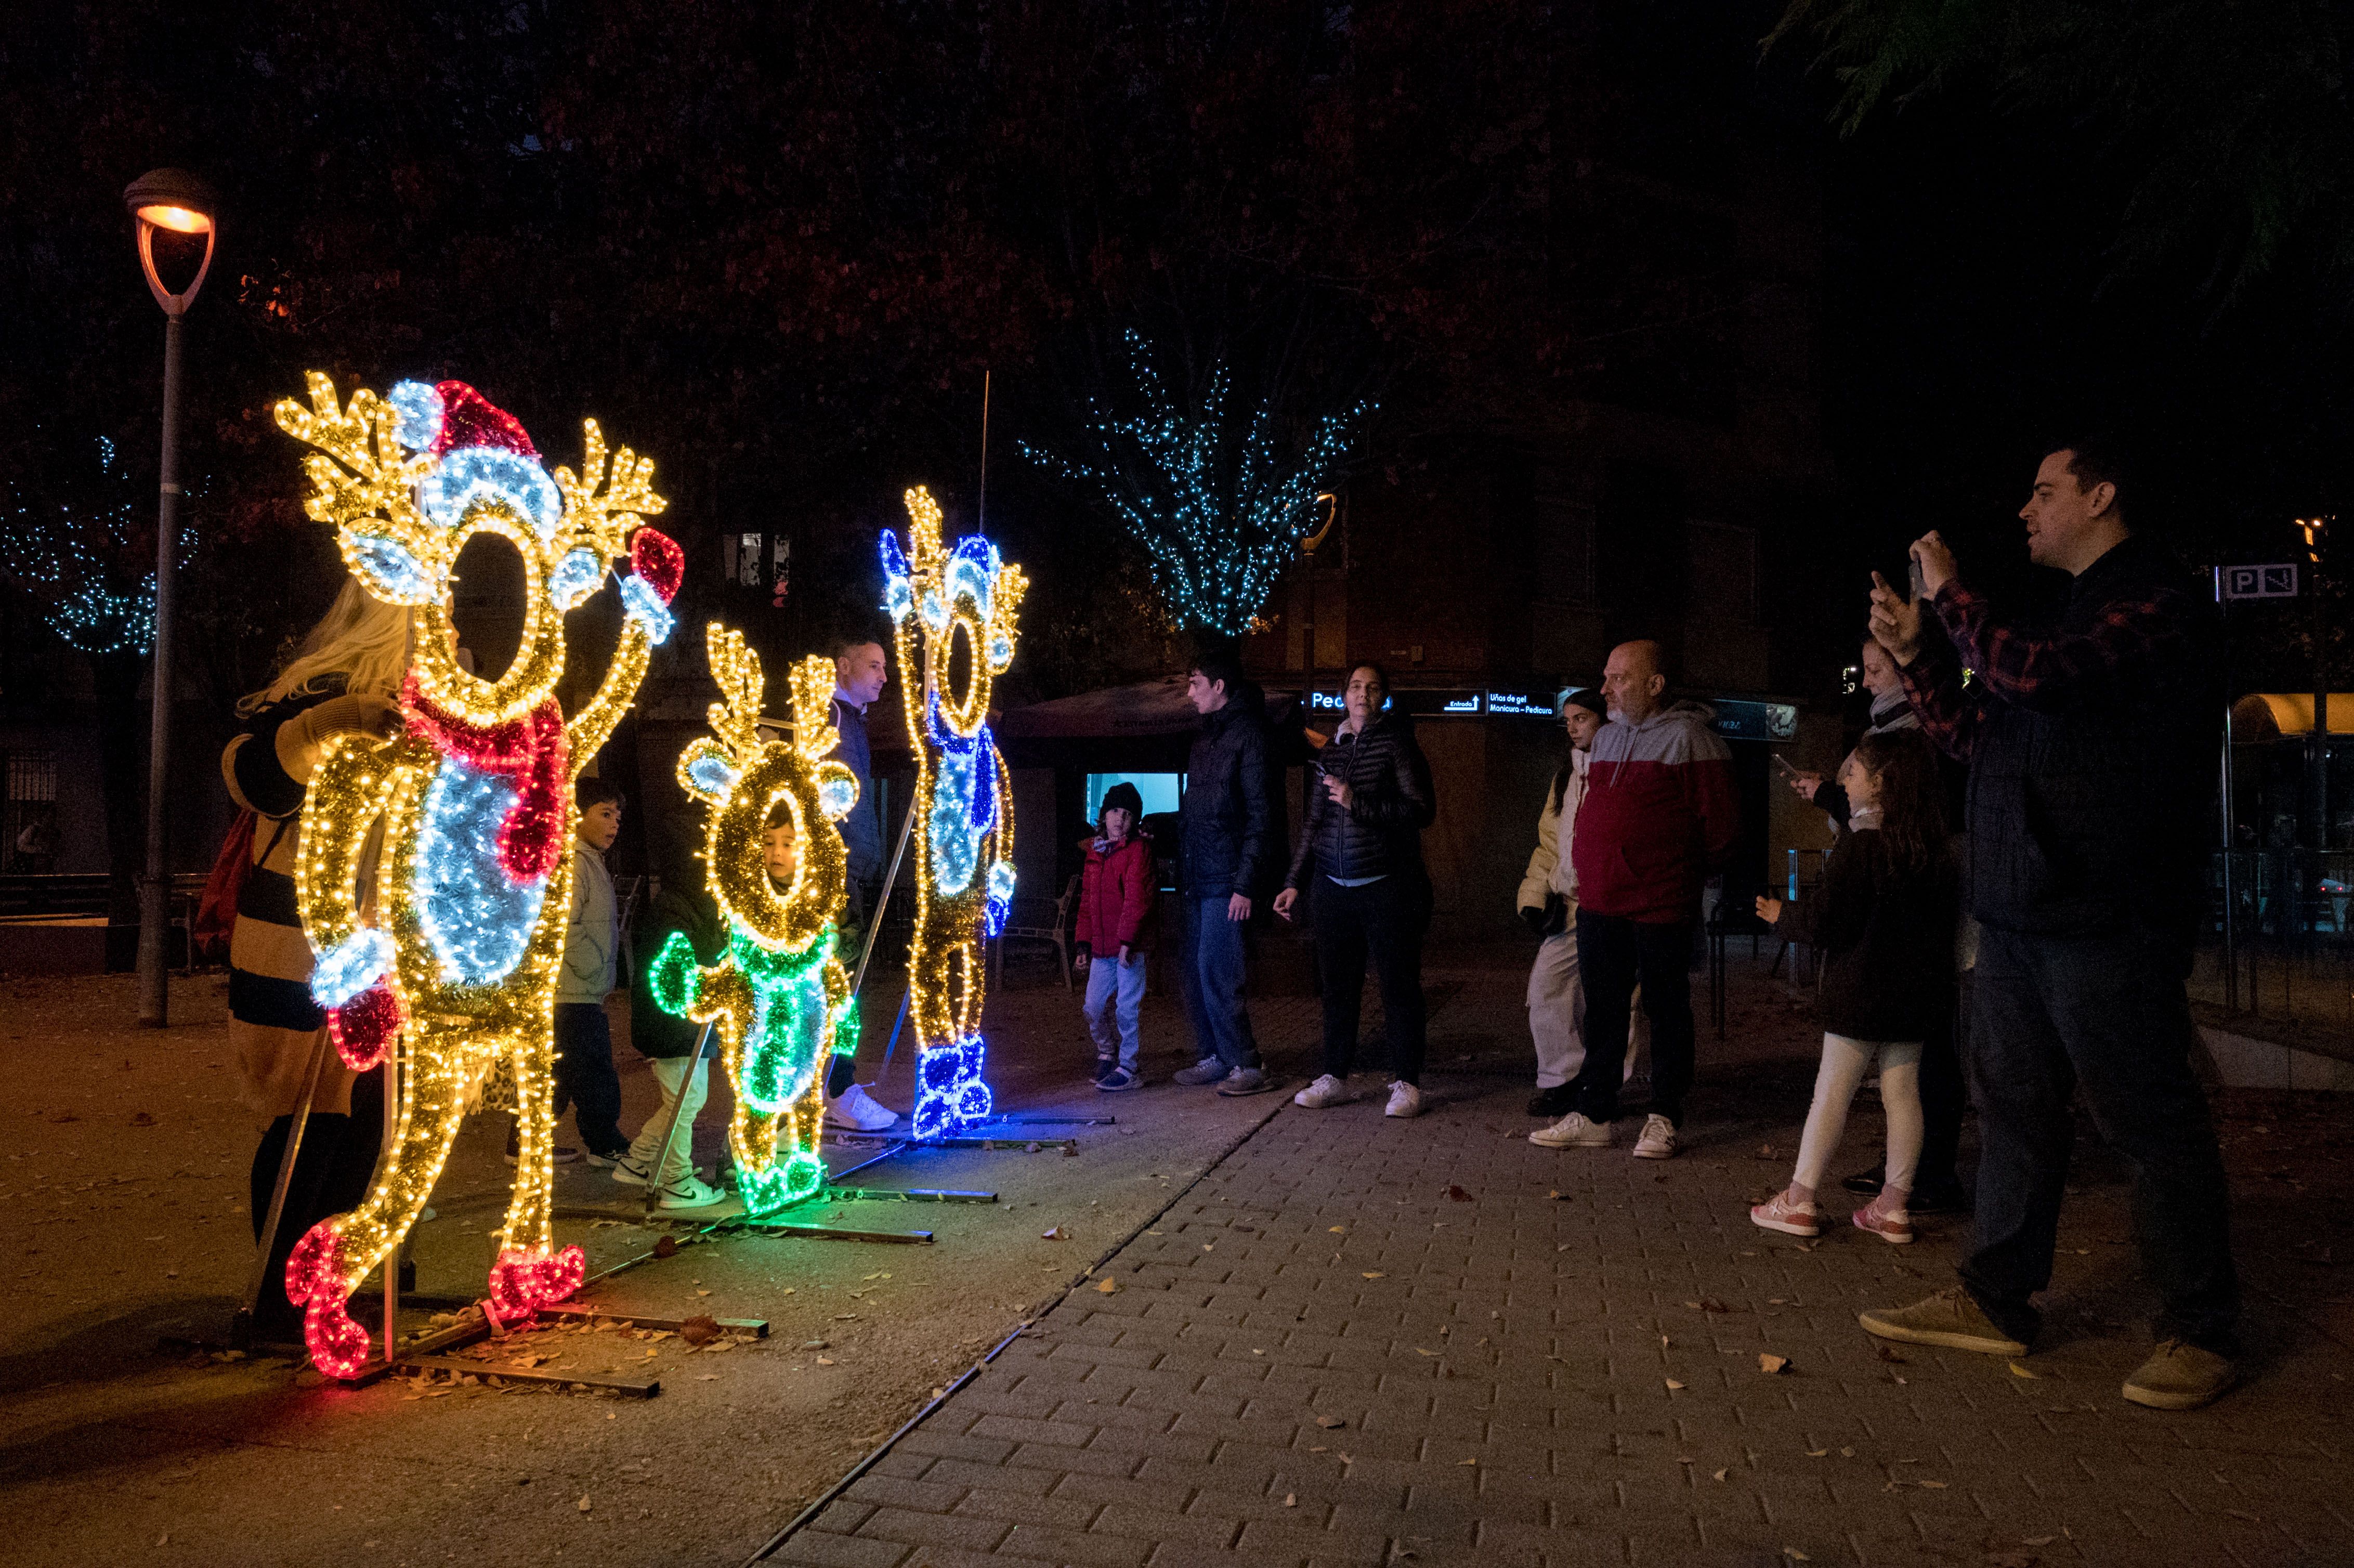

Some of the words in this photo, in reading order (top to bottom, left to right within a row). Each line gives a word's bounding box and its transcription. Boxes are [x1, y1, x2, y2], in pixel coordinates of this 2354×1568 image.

[2237, 572, 2253, 592] P
[1490, 694, 1506, 702] Uñas
[1516, 695, 1526, 704] gel
[1490, 704, 1519, 712] Manicura
[1525, 705, 1552, 714] Pedicura
